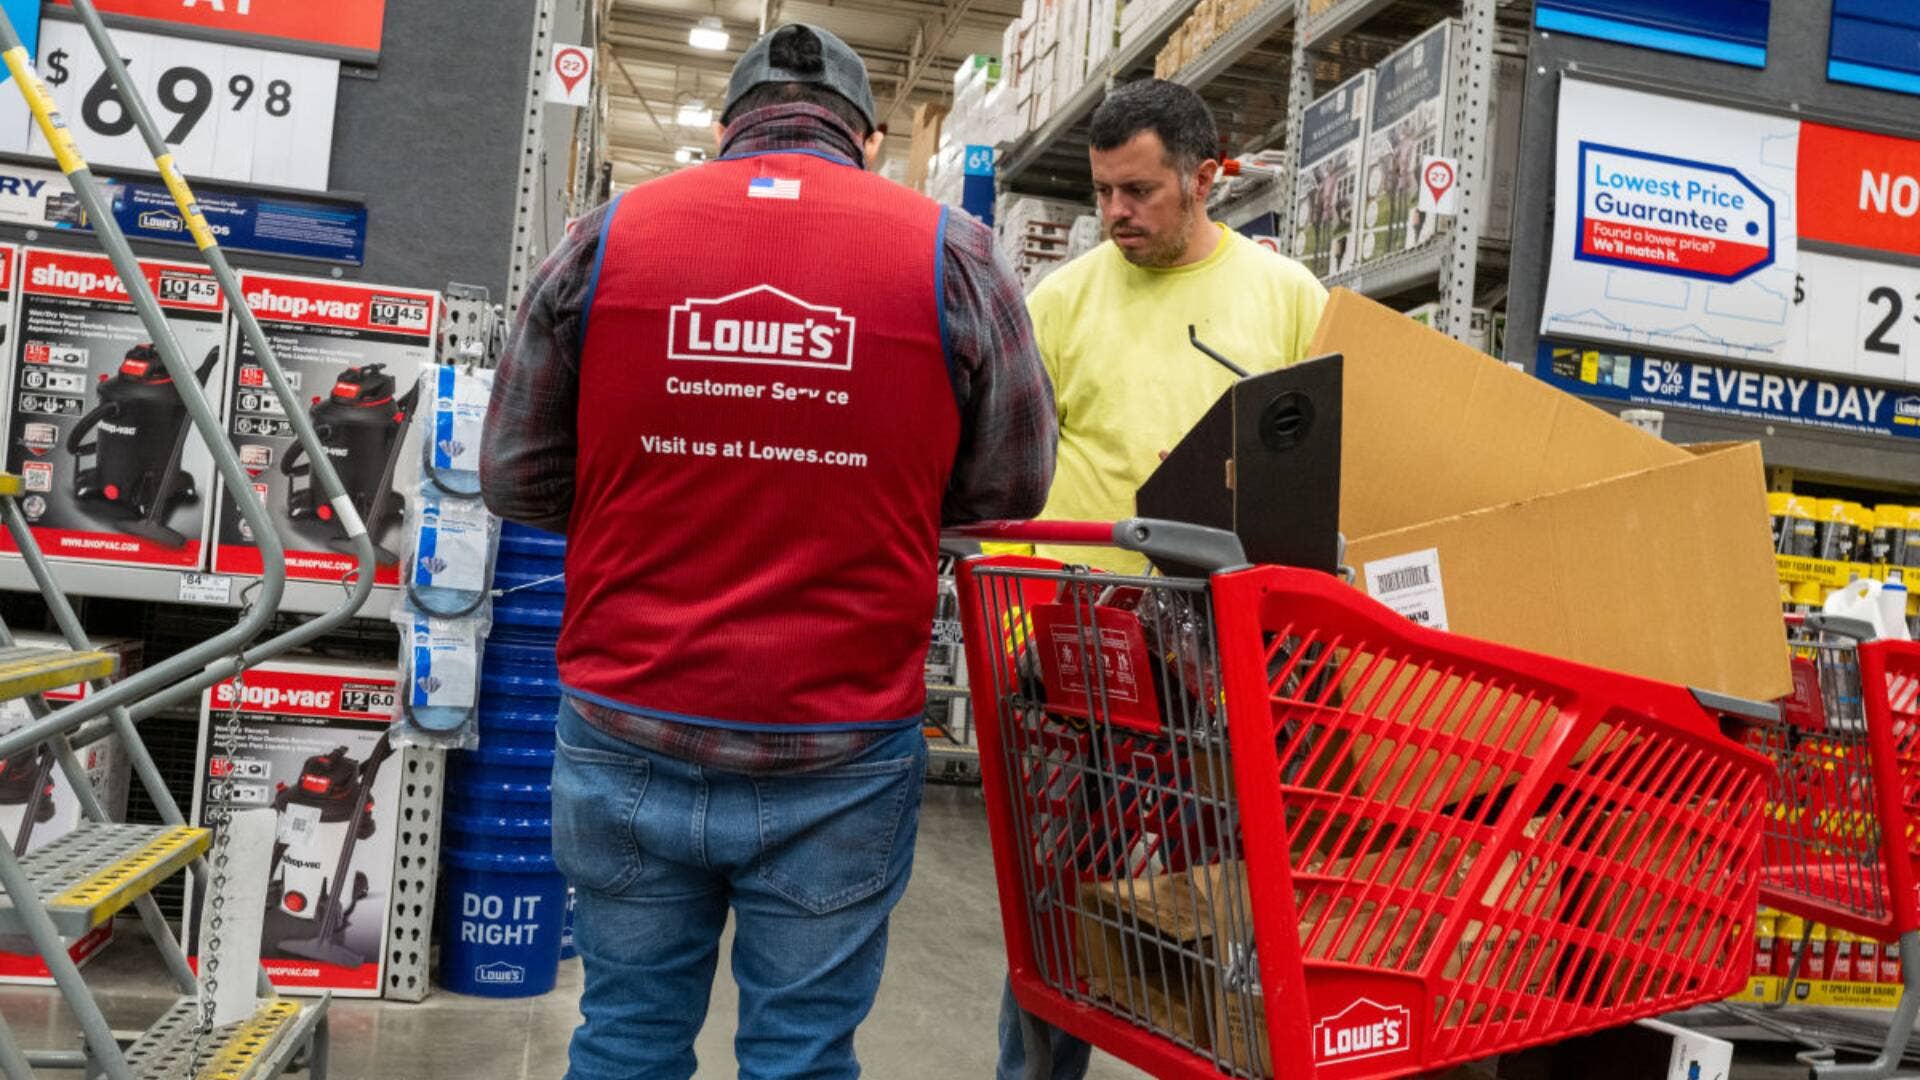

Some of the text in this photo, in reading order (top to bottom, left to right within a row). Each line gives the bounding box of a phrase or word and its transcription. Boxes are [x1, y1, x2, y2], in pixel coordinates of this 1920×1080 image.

[563, 60, 581, 72] 22
[1431, 172, 1447, 183] 27
[1594, 163, 1745, 210] Lowest Price
[143, 215, 179, 230] LOWE'S
[1594, 192, 1728, 233] Guarantee
[1592, 222, 1716, 254] Found a lower price?
[1592, 237, 1680, 262] We'll match it.
[164, 280, 217, 296] 10 4.5
[375, 305, 423, 321] 10 4.5
[1793, 273, 1805, 305] $
[1864, 286, 1903, 355] 2
[688, 311, 835, 360] LOWE'S
[666, 376, 849, 405] Customer Servce
[1689, 364, 1808, 413] EVERY
[1815, 381, 1886, 424] DAY
[640, 435, 868, 468] Visit us at Lowes.com
[344, 692, 394, 707] 12 6.0
[463, 892, 542, 920] DO IT
[461, 921, 540, 945] RIGHT
[480, 968, 520, 981] LOWE'S
[1323, 1017, 1400, 1057] LOWE'S
